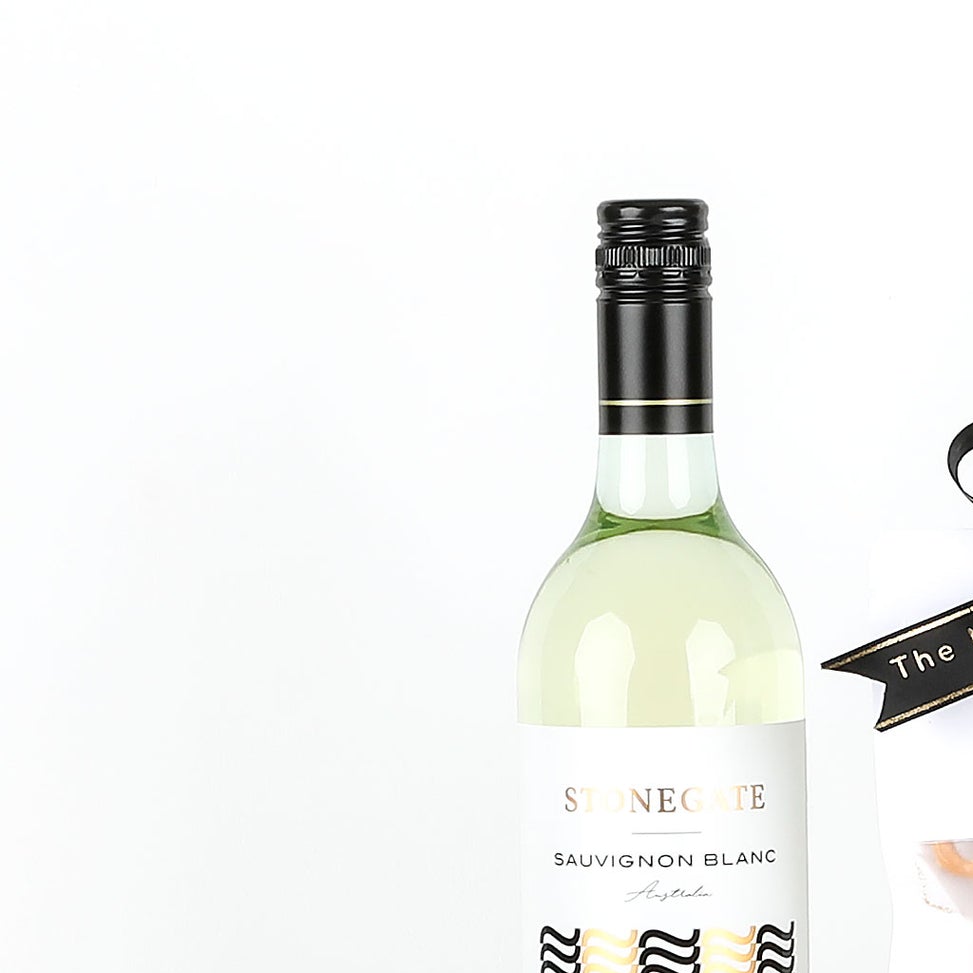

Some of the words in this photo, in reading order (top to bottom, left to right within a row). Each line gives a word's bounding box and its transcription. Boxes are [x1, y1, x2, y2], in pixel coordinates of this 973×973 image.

[889, 644, 955, 678] The
[565, 784, 765, 814] STONEGATE
[554, 852, 693, 868] SAUVIGNON
[704, 849, 777, 866] BLANC
